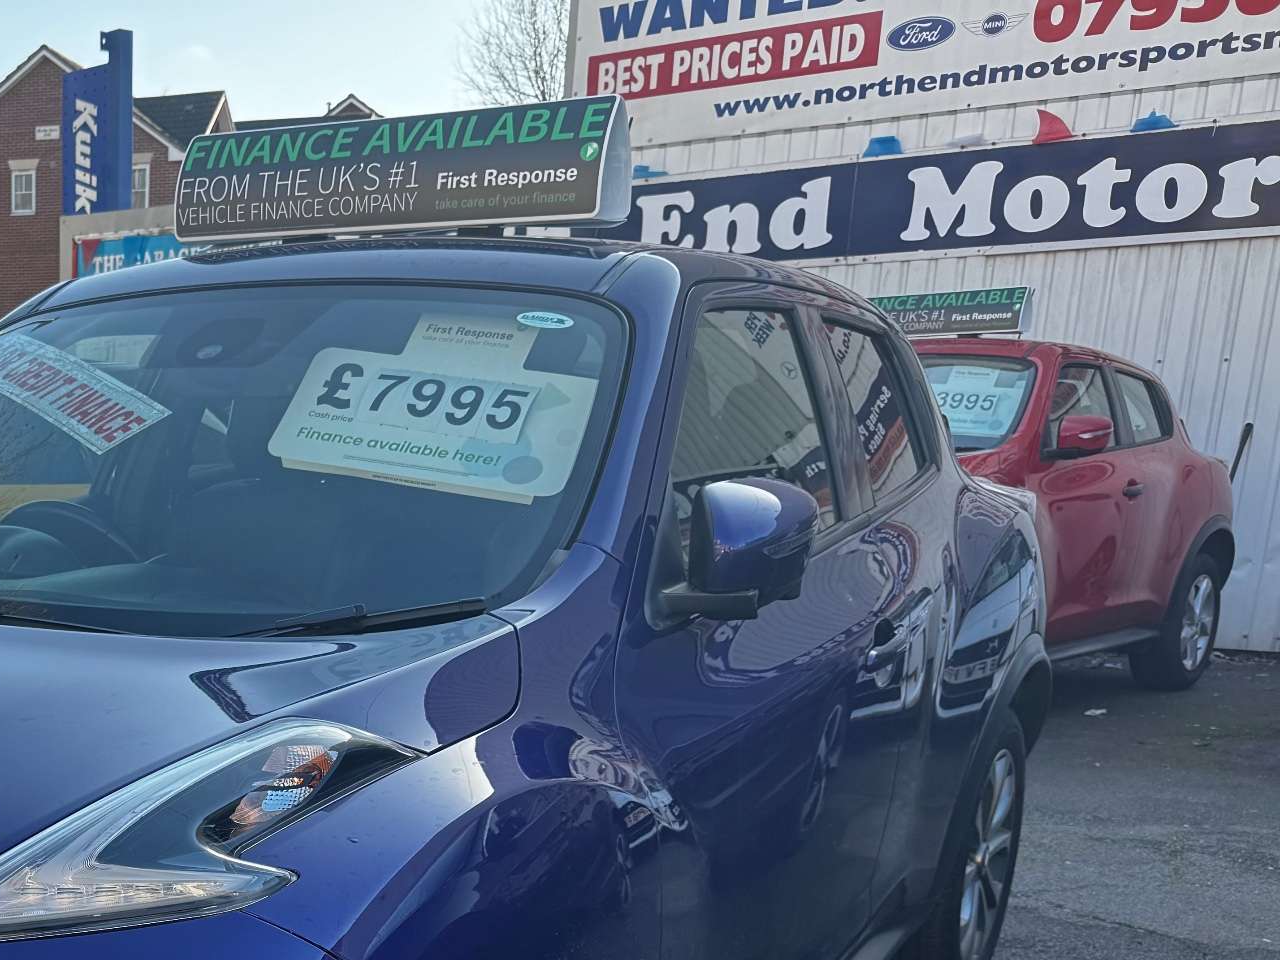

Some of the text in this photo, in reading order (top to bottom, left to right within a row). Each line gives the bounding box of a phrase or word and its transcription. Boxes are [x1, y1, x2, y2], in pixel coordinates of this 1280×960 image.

[898, 23, 942, 46] Ford
[597, 23, 866, 96] BEST PRICES PAID
[184, 103, 612, 171] FINANCE AVAILABLE
[72, 98, 98, 215] Kwik
[179, 173, 251, 205] FROM
[258, 168, 311, 198] THE
[387, 160, 419, 189] #1
[436, 168, 577, 190] First Response
[178, 192, 418, 227] VEHICLE FINANCE COMPANY
[435, 191, 576, 210] take care of your finance
[636, 176, 833, 253] End
[920, 289, 1026, 310] AVAILABLE
[931, 309, 945, 321] #1
[951, 311, 1012, 322] First Response
[425, 323, 514, 342] First Response
[903, 322, 944, 332] COMPANY
[2, 356, 76, 401] CREDIT
[49, 383, 146, 444] FINANCE
[936, 391, 997, 412] 3995
[308, 409, 354, 424] Cash price
[296, 427, 363, 448] Finance
[366, 436, 450, 460] available
[454, 448, 502, 467] here!
